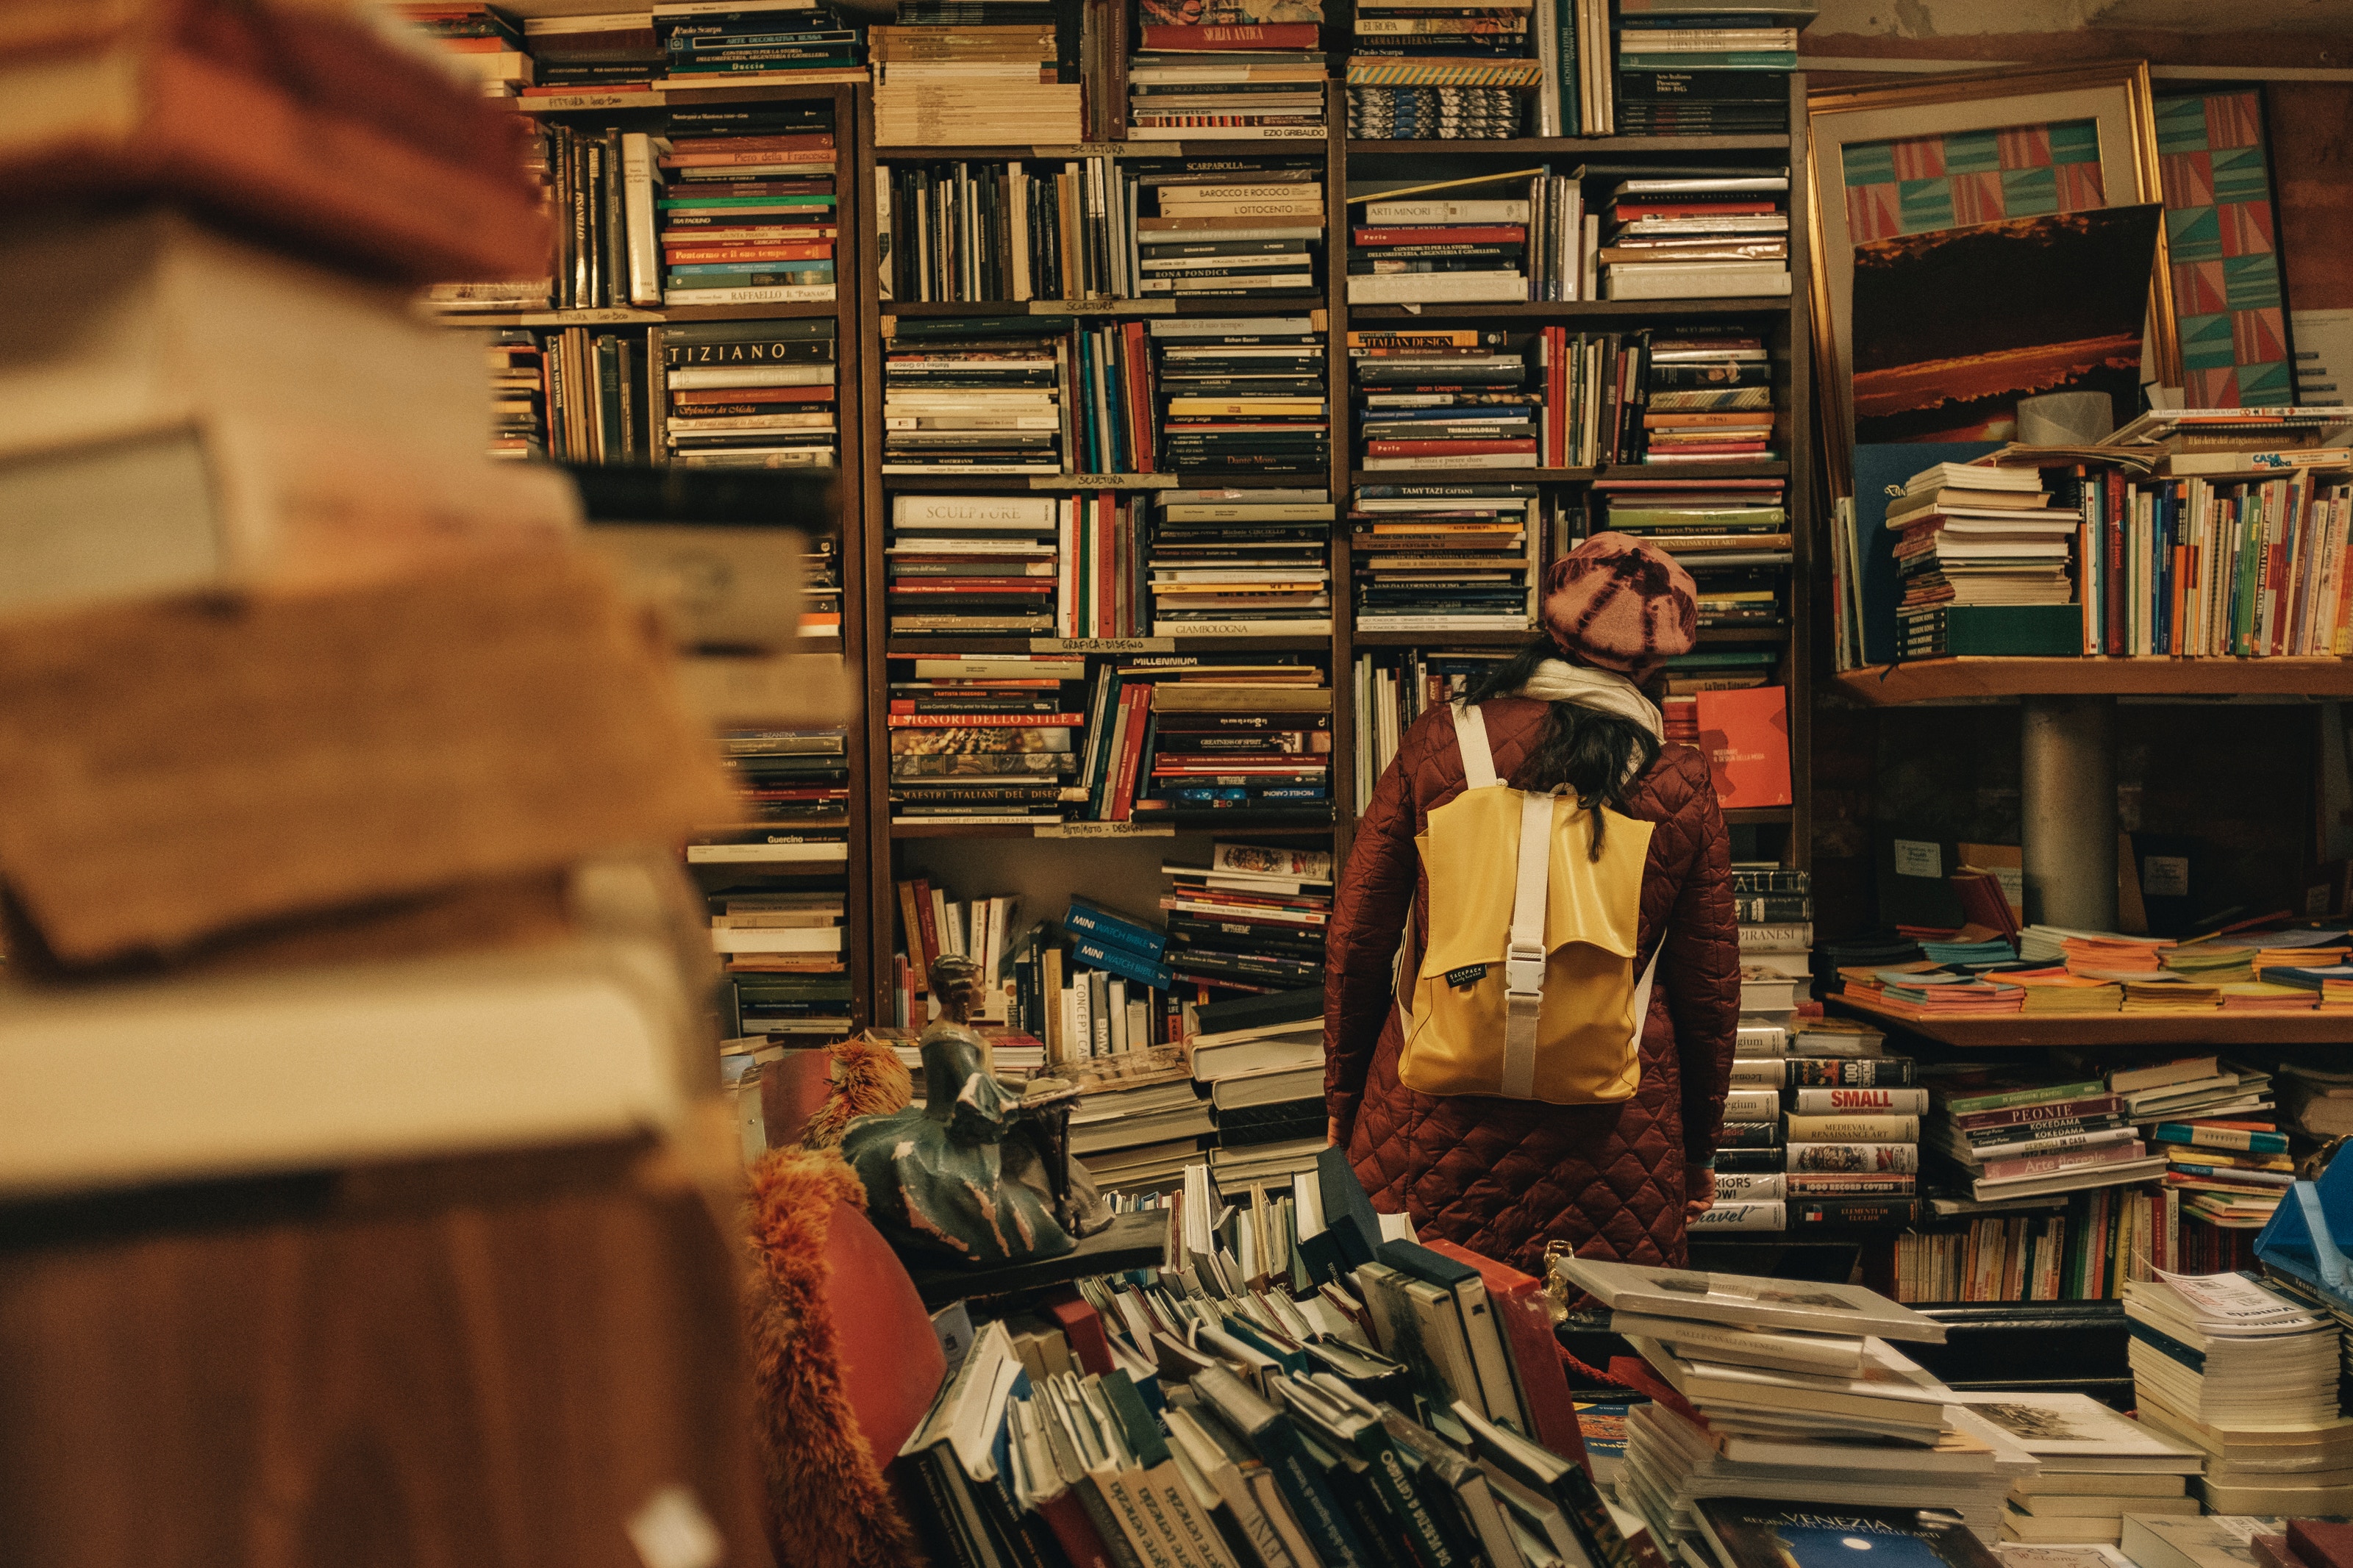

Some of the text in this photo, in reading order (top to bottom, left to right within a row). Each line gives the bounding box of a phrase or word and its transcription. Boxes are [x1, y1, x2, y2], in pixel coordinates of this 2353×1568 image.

[1363, 21, 1397, 31] EUROPA
[1071, 145, 1126, 155] SCULTURA
[735, 151, 830, 162] Piero della Francesca
[1199, 189, 1242, 197] BAROCCO
[1251, 188, 1290, 196] ROCOCO
[1234, 204, 1293, 215] L'OTTOCENTO
[1394, 207, 1430, 215] MINORI
[676, 251, 718, 259] Pontormo
[758, 249, 787, 257] tempo
[1185, 268, 1229, 277] PONDICK
[731, 290, 781, 301] RAFFAELLO
[1066, 301, 1115, 311] SCULTURA
[1365, 337, 1452, 347] ITALIAN DESIGN
[670, 343, 785, 362] TIZIANO
[679, 407, 715, 416] Splendore
[1227, 455, 1277, 464] Dante Moro
[2252, 454, 2282, 464] CASA
[1078, 476, 1124, 485] SCULTURA
[926, 506, 1021, 519] SCULPTURE
[1175, 624, 1248, 634] GIAMBOLOGNA
[1062, 640, 1143, 650] GRAFICA-DISEGNO
[1133, 657, 1198, 666] MILLENNIUM
[903, 715, 966, 725] SIGNORI
[972, 715, 1021, 724] DELLO
[1026, 714, 1069, 723] STILE
[762, 731, 796, 739] BIZANTINA
[903, 790, 1061, 799] MAESTRI ITALIANI DEL DISEG
[767, 835, 804, 843] Guercino
[1073, 915, 1148, 948] MINI WATCH BIBLE
[1738, 929, 1795, 941] PIRANESI
[1082, 945, 1104, 959] MINI
[1104, 953, 1135, 971] WATCH
[1450, 967, 1482, 979] SACKPACK
[1076, 984, 1088, 1034] CONCEPT
[1098, 1019, 1110, 1056] BMW
[1831, 1091, 1893, 1107] SMALL
[2012, 1103, 2073, 1123] PEONIE
[2029, 1118, 2081, 1131] KOKEDAMA
[1811, 1131, 1871, 1139] RENAISSANCE
[2035, 1126, 2085, 1139] KOKEDAMA
[2024, 1153, 2105, 1173] Arte floreale
[1715, 1178, 1751, 1188] RIORS
[1715, 1189, 1737, 1198] OW!
[1700, 1206, 1749, 1222] ravel
[2227, 1304, 2296, 1318] Venezia
[1407, 1497, 1420, 1509] A
[1110, 1481, 1147, 1537] venezia
[1138, 1486, 1176, 1542] venezia
[1165, 1486, 1203, 1542] venezia
[1779, 1512, 1893, 1531] VENEZIA
[1743, 1517, 1792, 1527] REGINA
[1913, 1530, 1941, 1539] ARTI
[1435, 1547, 1452, 1567] DA
[2012, 1551, 2079, 1564] Welcome
